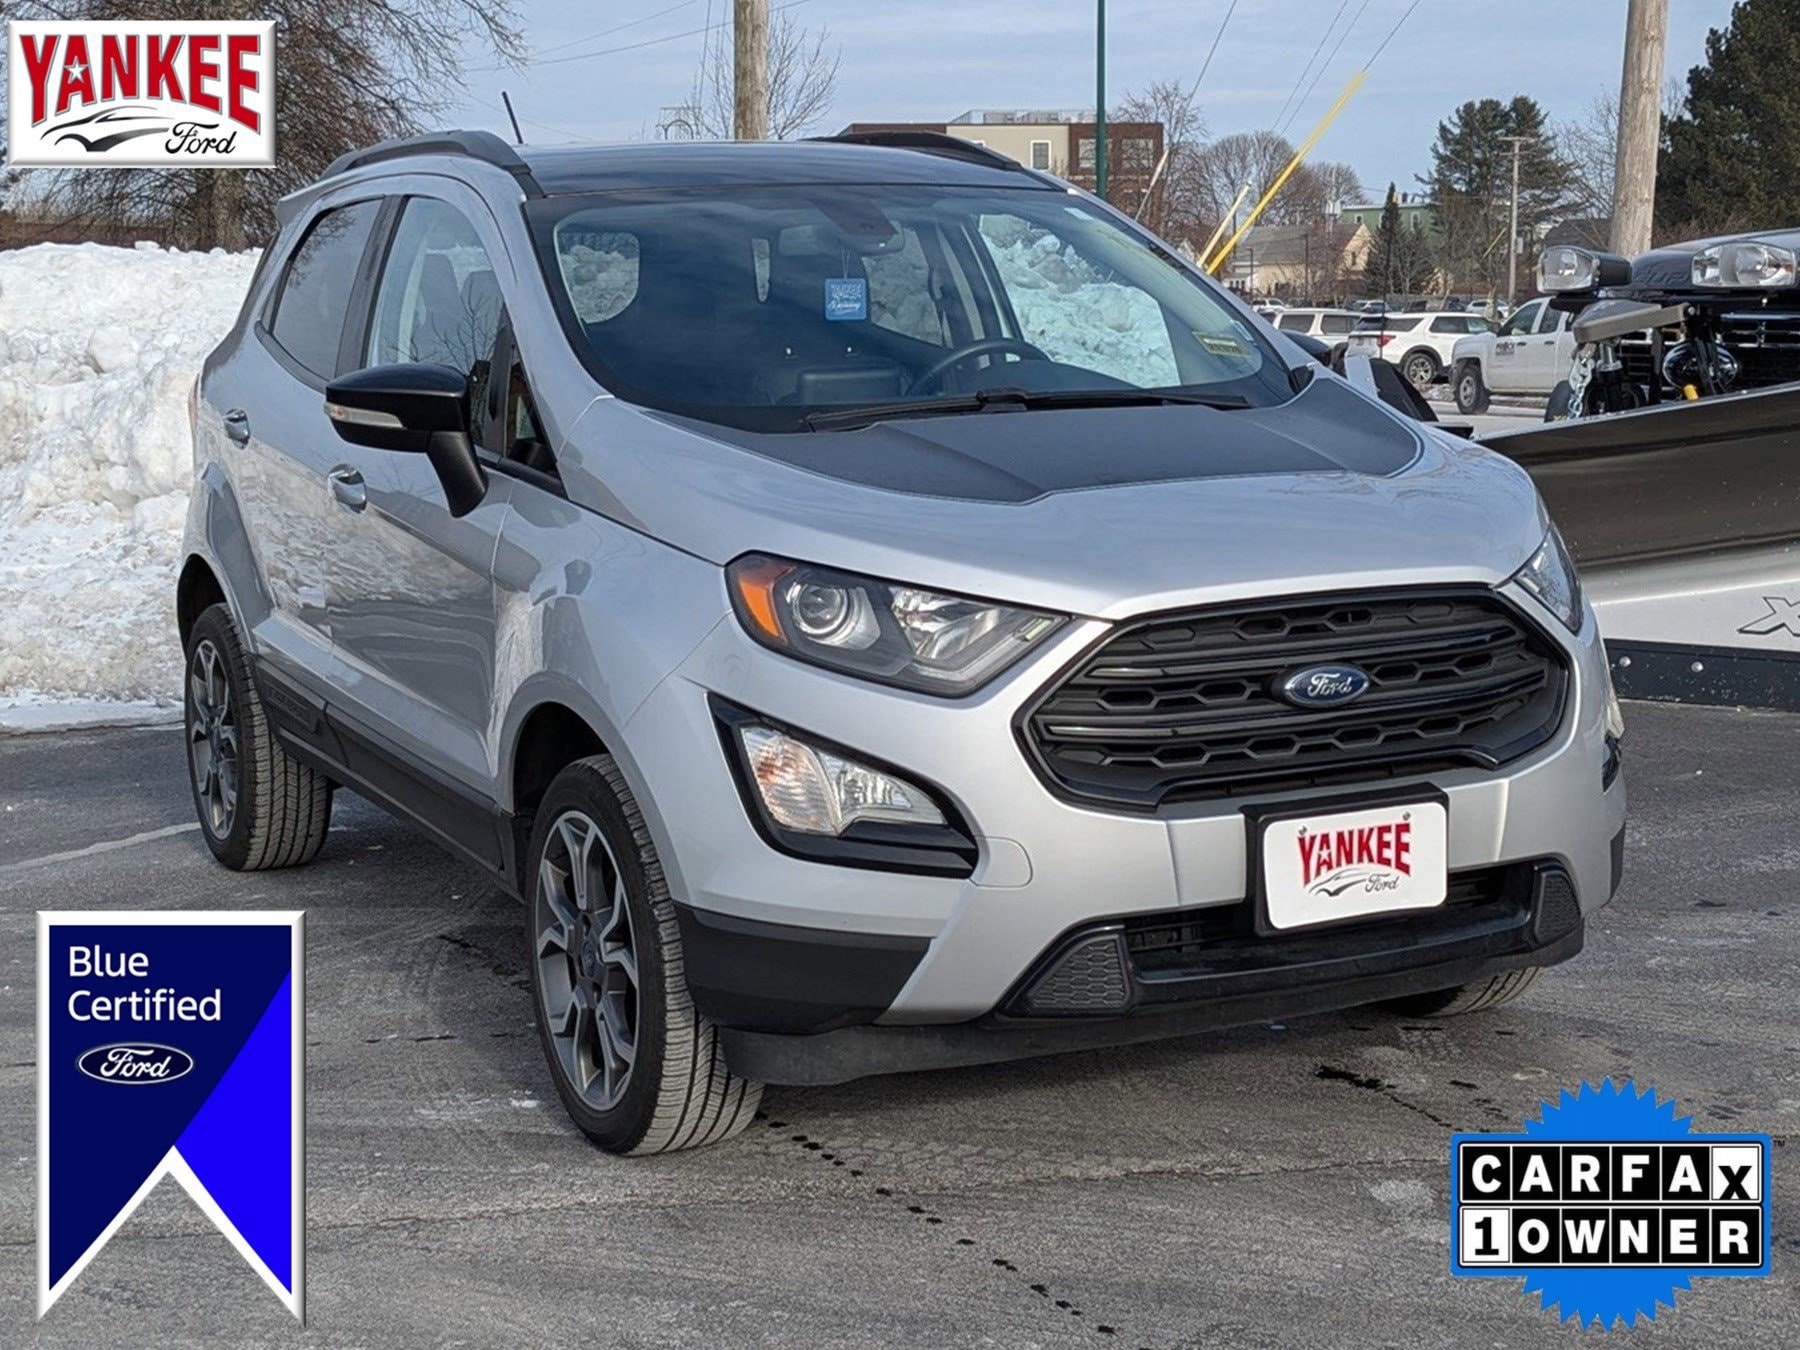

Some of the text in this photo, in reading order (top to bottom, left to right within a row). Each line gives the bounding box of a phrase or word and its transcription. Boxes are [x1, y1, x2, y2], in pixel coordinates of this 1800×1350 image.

[1307, 673, 1352, 697] Ford
[1297, 822, 1411, 888] YANKEE
[1365, 873, 1399, 893] Ford
